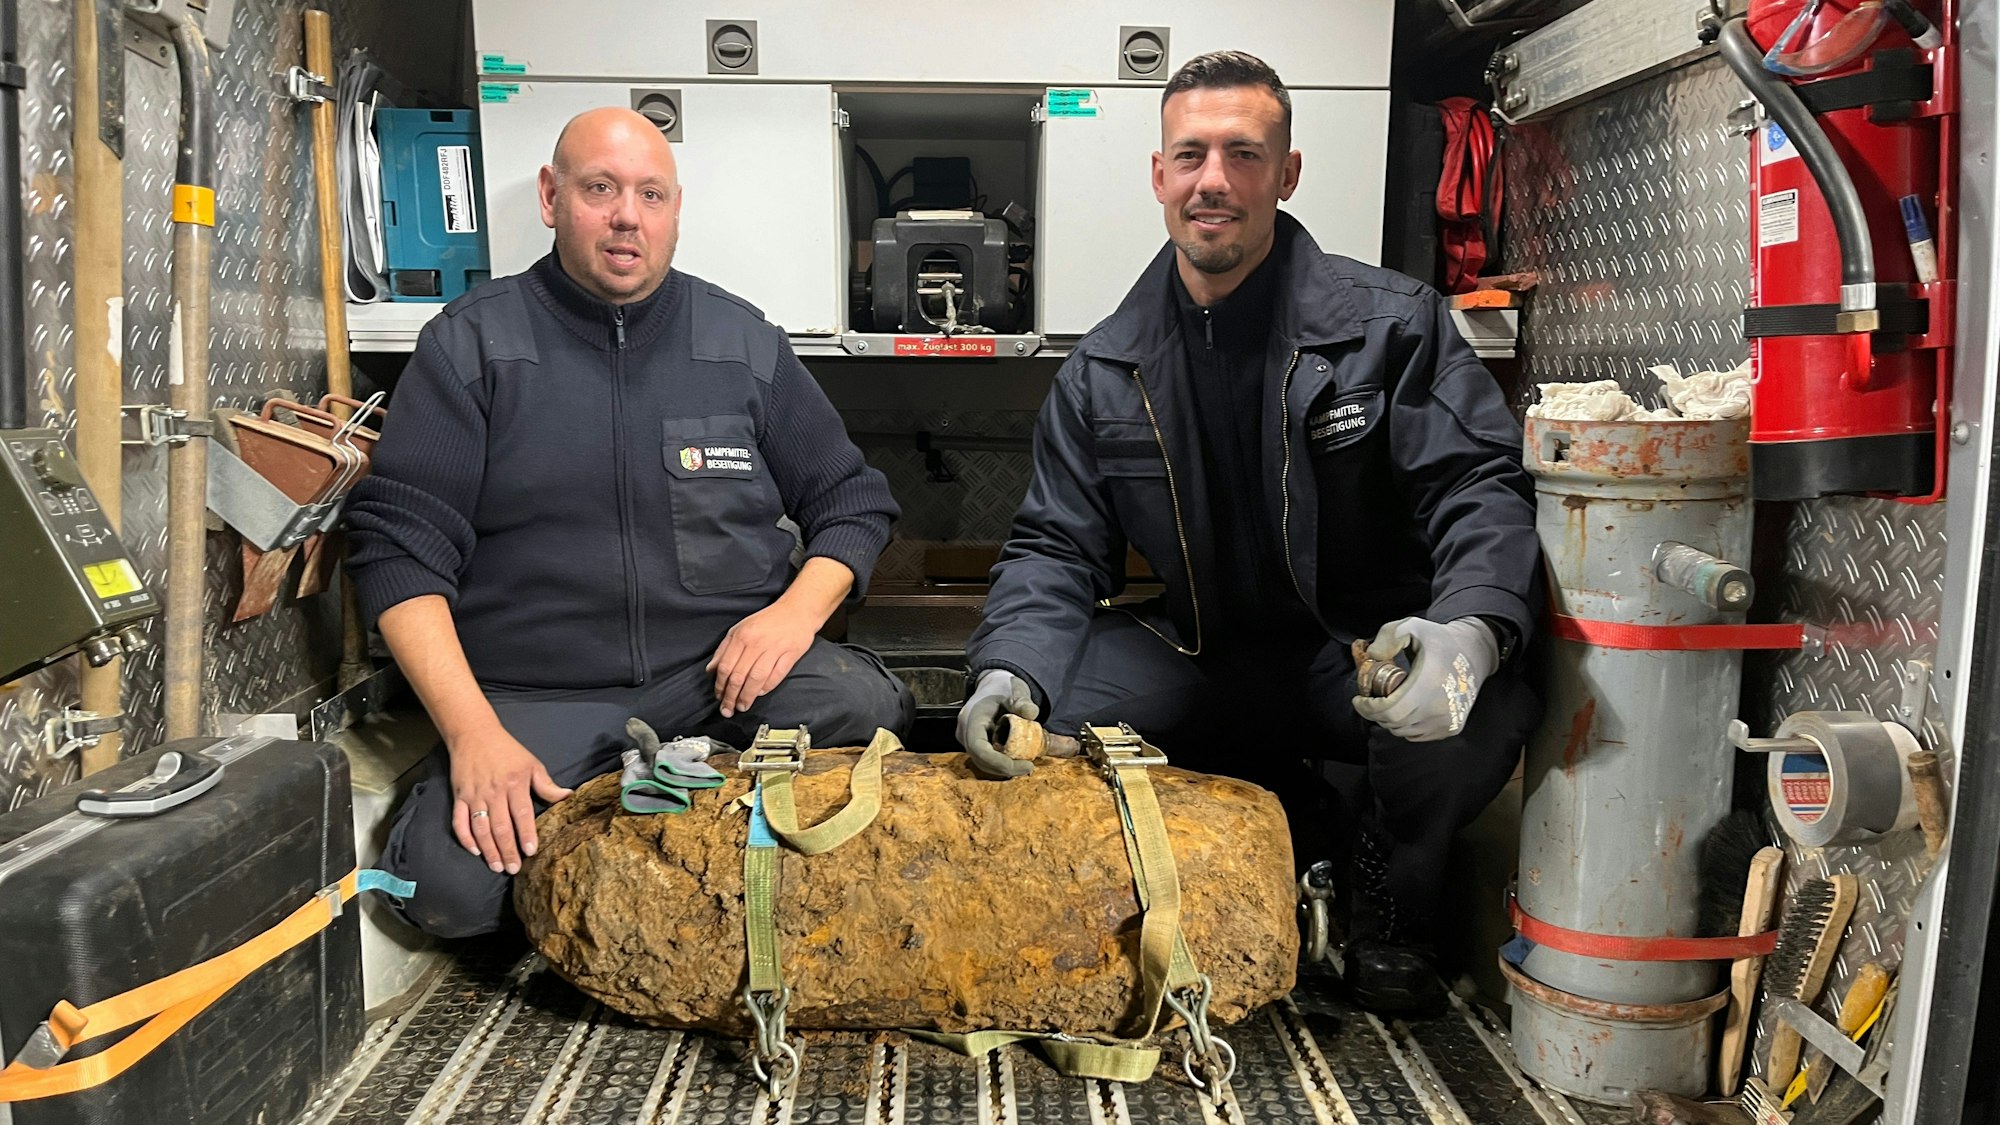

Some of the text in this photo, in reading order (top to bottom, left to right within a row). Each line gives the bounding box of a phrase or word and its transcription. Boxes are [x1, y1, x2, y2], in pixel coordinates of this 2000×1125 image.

[440, 148, 451, 190] DDF482RFJ
[897, 343, 992, 352] max. Zuglast 300 kg
[1310, 416, 1366, 440] BESEITIGUNG
[704, 447, 752, 459] KAMPFMITTEL-
[706, 459, 753, 471] BESEITIGUNG
